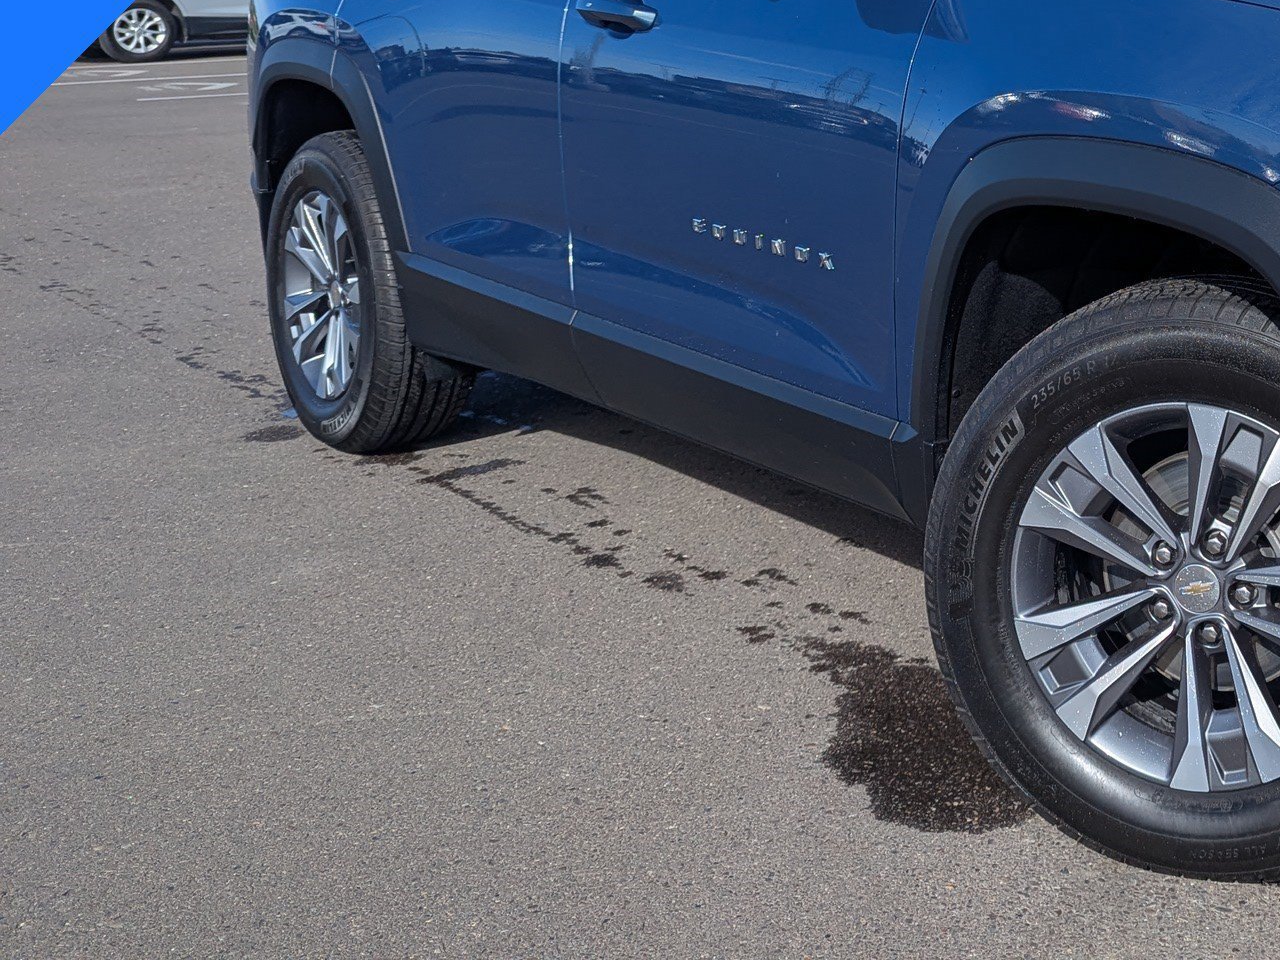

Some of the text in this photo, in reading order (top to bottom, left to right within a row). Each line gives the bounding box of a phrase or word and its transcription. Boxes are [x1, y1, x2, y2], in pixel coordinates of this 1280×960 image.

[692, 218, 835, 270] EQUINOX
[1031, 368, 1081, 409] 235/65
[956, 419, 1019, 548] MICHELIN
